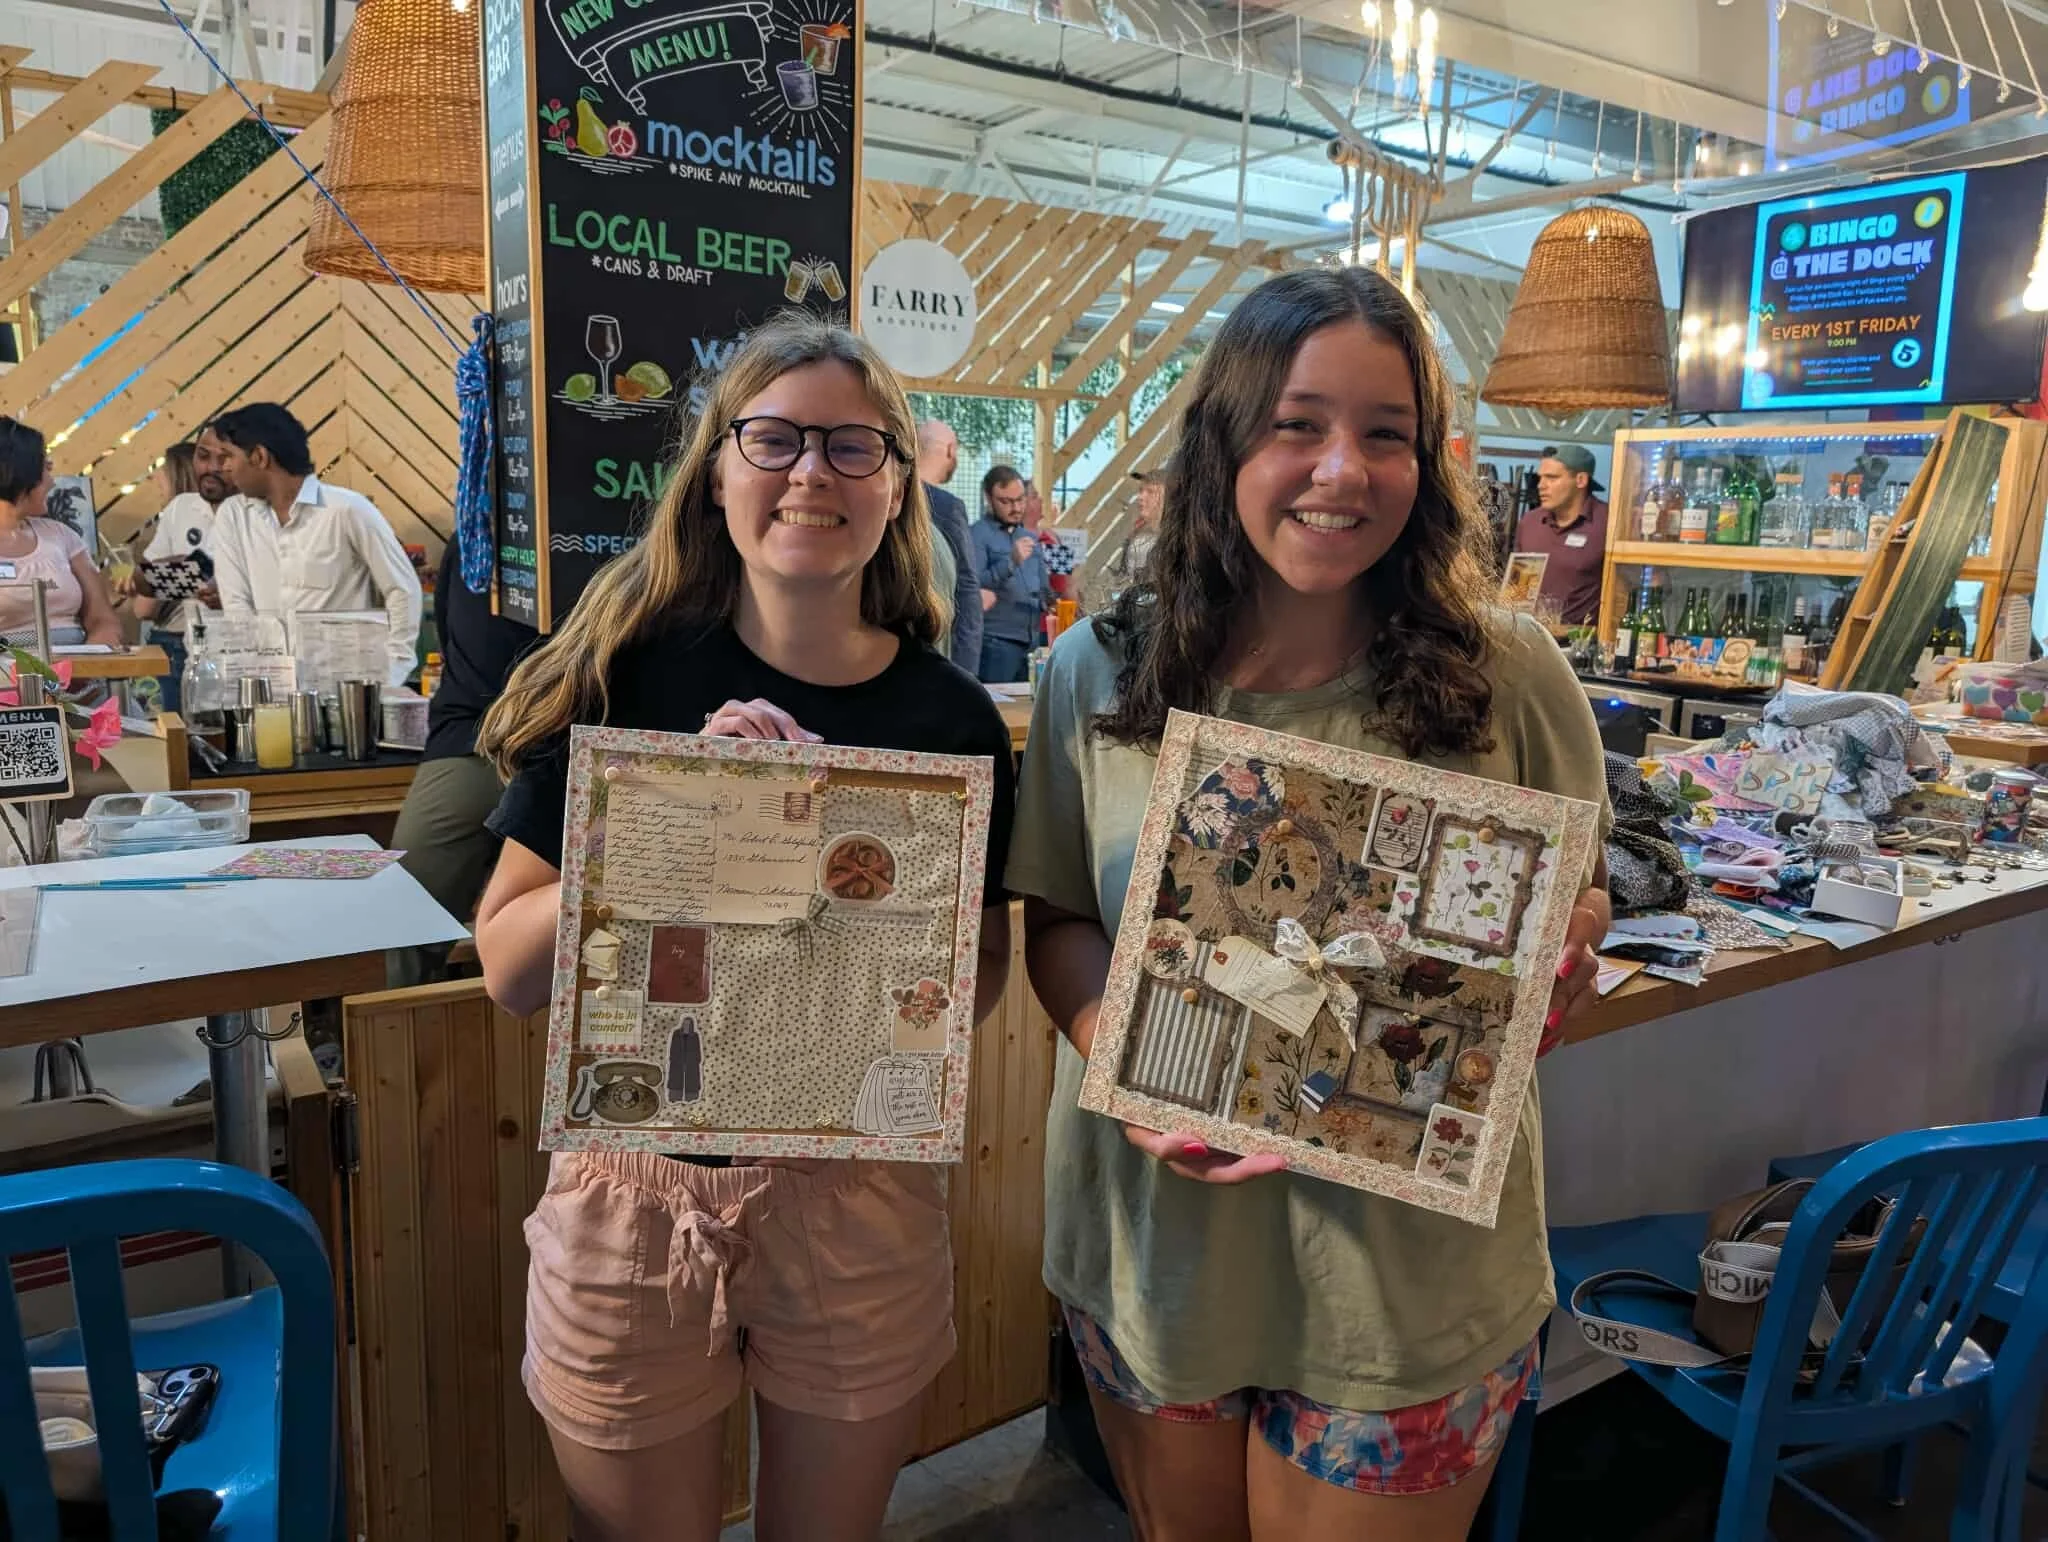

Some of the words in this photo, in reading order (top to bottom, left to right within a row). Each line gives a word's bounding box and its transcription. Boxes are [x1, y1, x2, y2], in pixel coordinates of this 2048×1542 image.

[560, 0, 614, 41] NEW
[488, 34, 511, 88] BAR
[630, 21, 732, 78] MENU!
[492, 128, 524, 177] menus
[647, 120, 836, 186] mocktails
[719, 171, 743, 187] ANY
[749, 177, 812, 199] MOCKTAIL
[548, 203, 682, 264] LOCAL
[697, 226, 792, 278] BEER
[1808, 213, 1898, 248] BINGO
[647, 260, 661, 280] &
[666, 264, 714, 287] DRAFT
[1770, 255, 1789, 280] @
[1793, 250, 1849, 278] THE
[1853, 239, 1935, 272] DOCK
[496, 265, 528, 312] hours
[871, 284, 970, 318] FARRY
[1771, 322, 1822, 341] EVERY
[1825, 319, 1855, 337] 1ST
[1859, 314, 1922, 334] FRIDAY
[1897, 343, 1916, 363] 5
[584, 534, 643, 555] SPEC
[589, 1009, 612, 1020] who
[614, 1009, 626, 1020] is
[628, 1009, 638, 1020] in
[590, 1022, 635, 1034] control?
[1581, 1321, 1640, 1353] ORS
